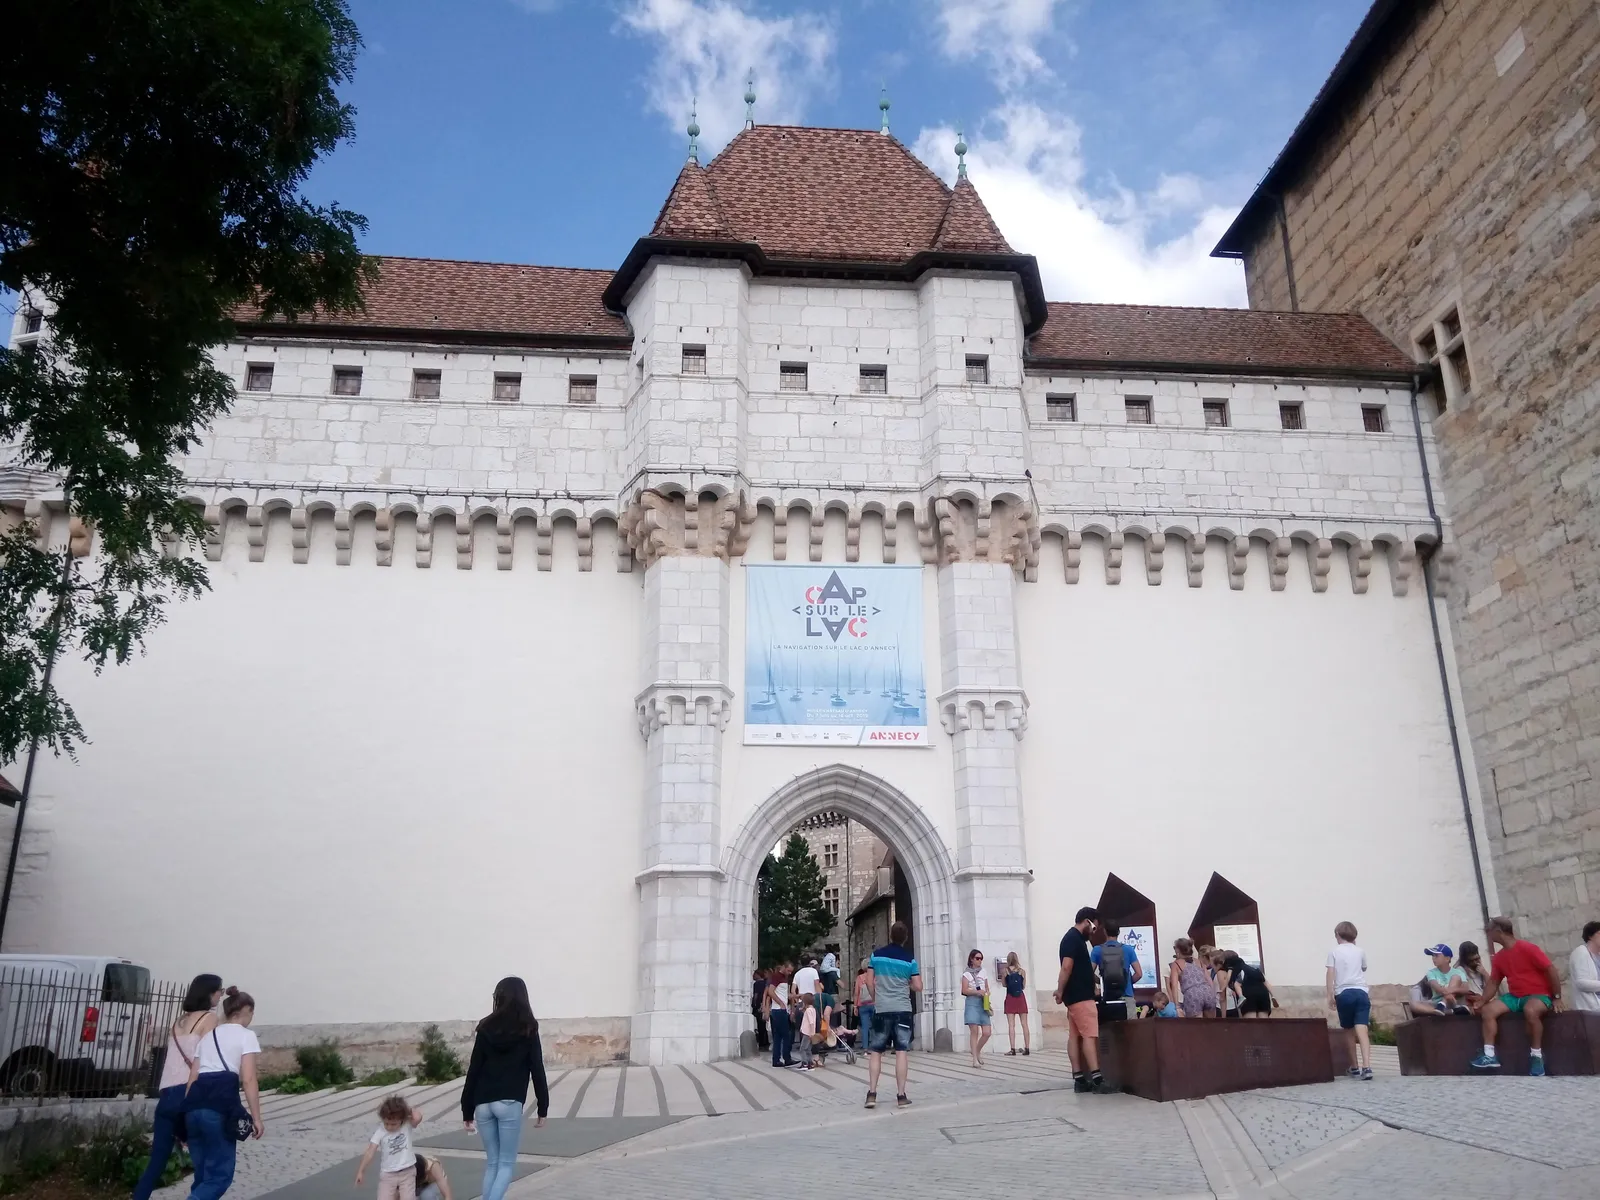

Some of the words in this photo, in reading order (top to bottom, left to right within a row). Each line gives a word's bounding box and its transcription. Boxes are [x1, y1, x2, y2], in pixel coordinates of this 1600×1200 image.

[805, 570, 867, 604] CAP
[806, 605, 839, 616] SUR
[848, 605, 867, 616] LE
[870, 731, 920, 741] ANNECY
